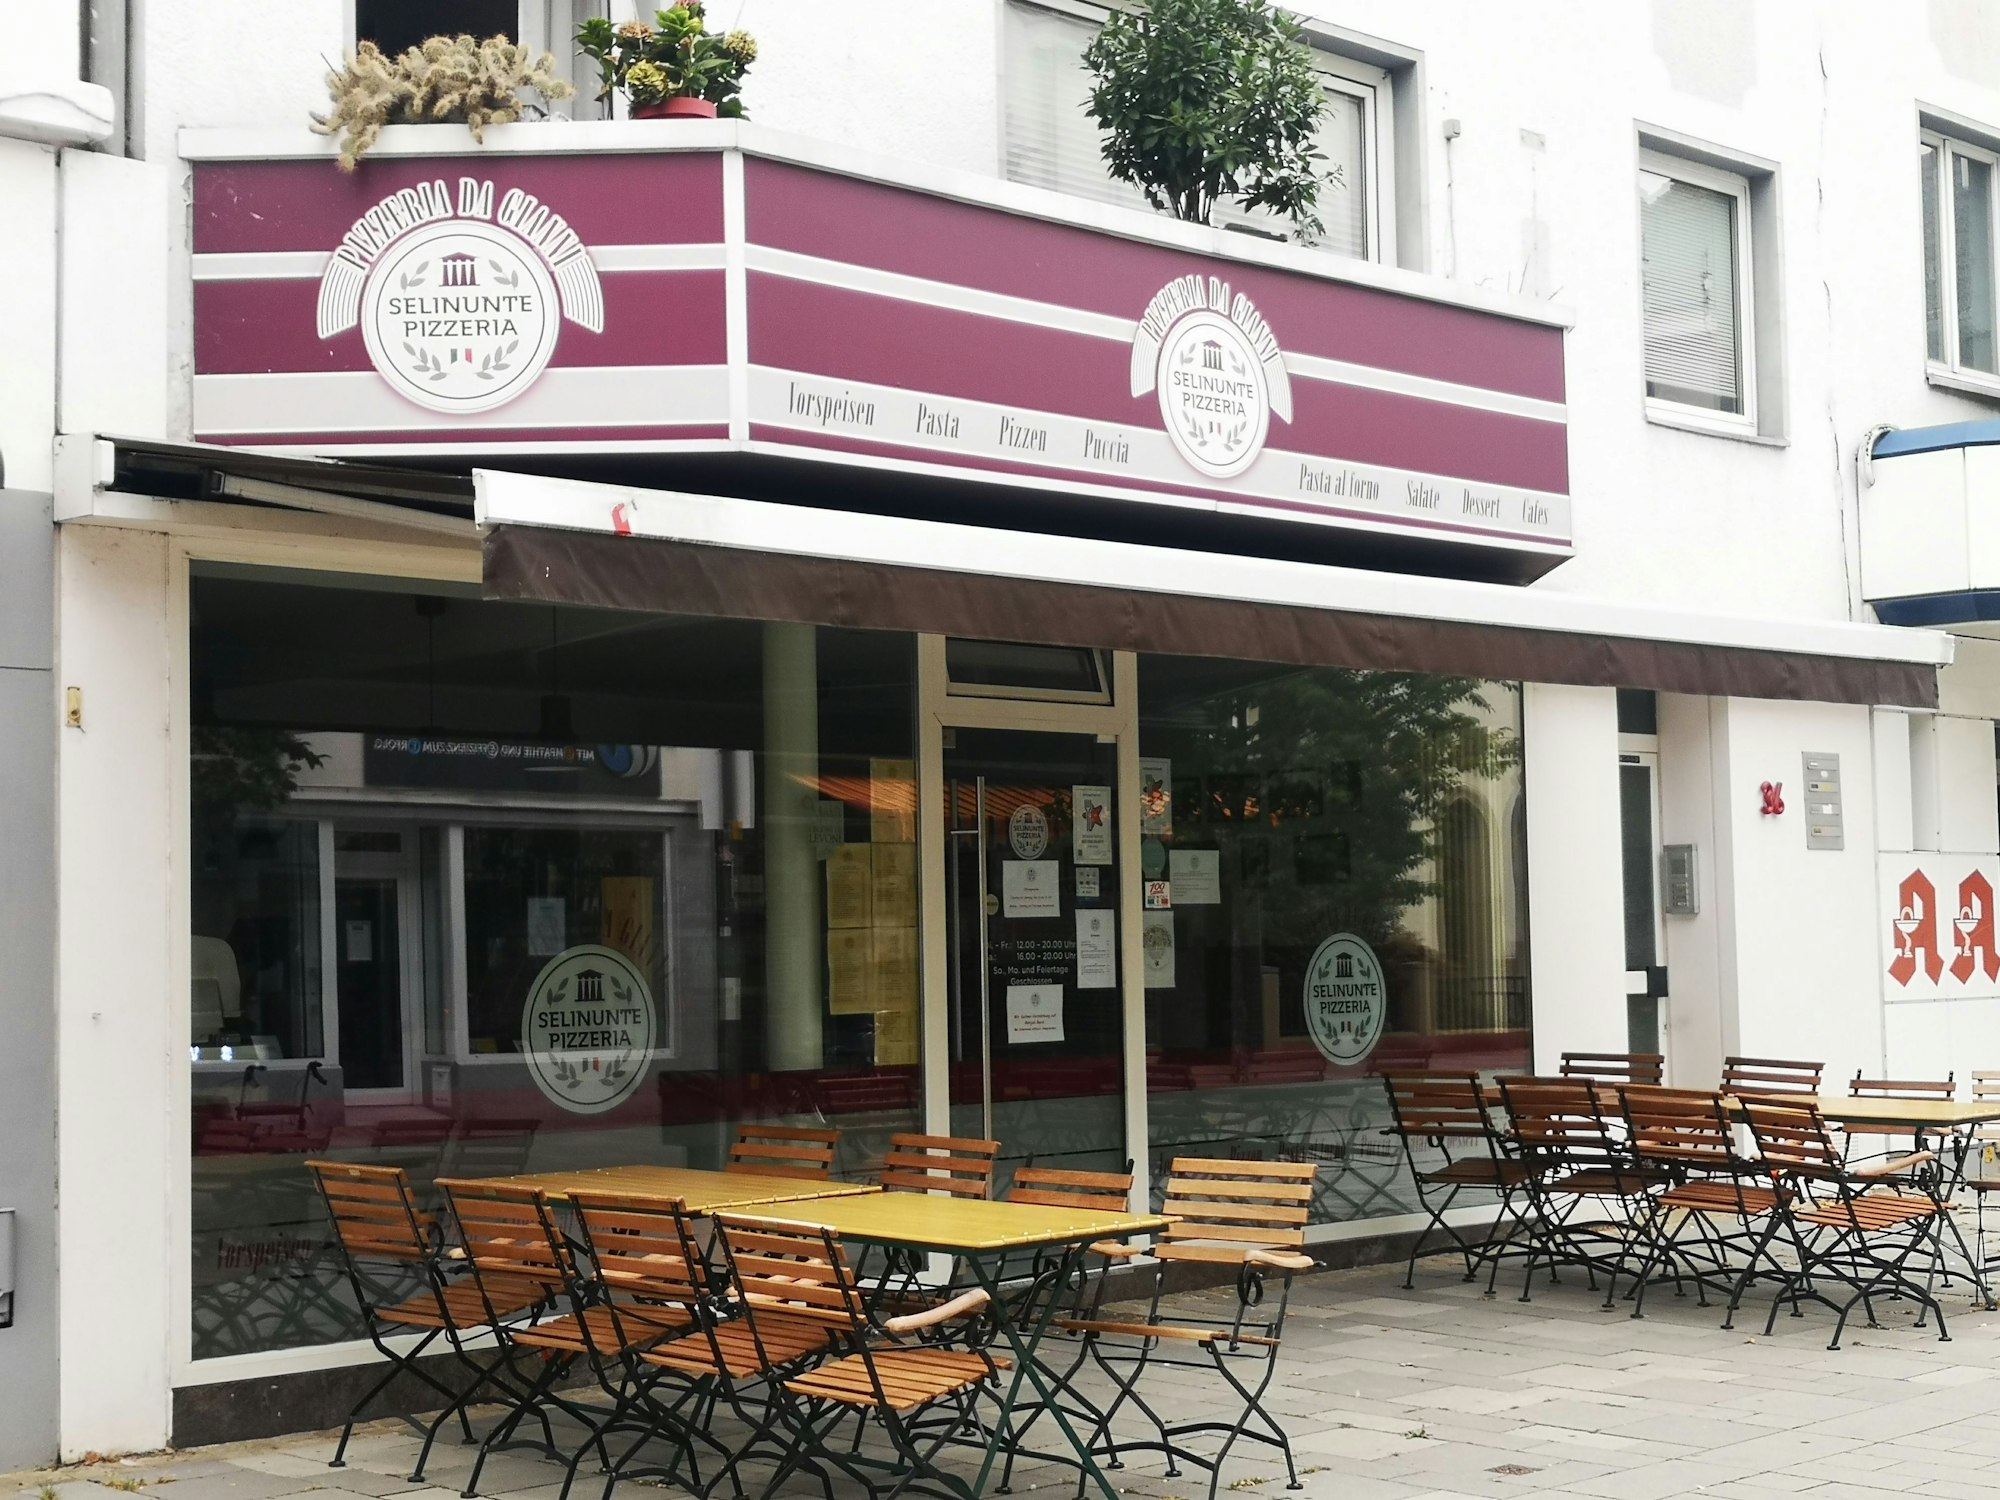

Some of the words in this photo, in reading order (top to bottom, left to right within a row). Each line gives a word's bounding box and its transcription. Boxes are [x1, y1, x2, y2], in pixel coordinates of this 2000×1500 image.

[337, 180, 451, 271] PIZZERIA
[461, 179, 493, 218] DA
[500, 189, 582, 268] GIANNI
[389, 295, 533, 315] SELINUNTE
[1141, 275, 1206, 343] PIZZERIA
[1209, 278, 1230, 315] DA
[403, 319, 518, 338] PIZZERIA
[1173, 371, 1254, 400] SELINUNTE
[1182, 392, 1247, 418] PIZZERIA
[788, 381, 877, 427] Vorspeisen
[915, 401, 961, 440] Pasta
[998, 414, 1048, 452] Pizzen
[1084, 428, 1130, 465] Puccia
[1298, 463, 1332, 494] Pasta
[1334, 469, 1347, 497] al
[1347, 471, 1380, 501] forno
[1405, 479, 1441, 511] Salate
[1461, 487, 1501, 519] Dessert
[1022, 966, 1035, 974] und
[1036, 965, 1069, 974] Feiertage
[1313, 982, 1377, 998] SELINUNTE
[1319, 999, 1371, 1015] PIZZERIA
[538, 1008, 642, 1028] SELINUNTE
[549, 1030, 632, 1049] PIZZERIA
